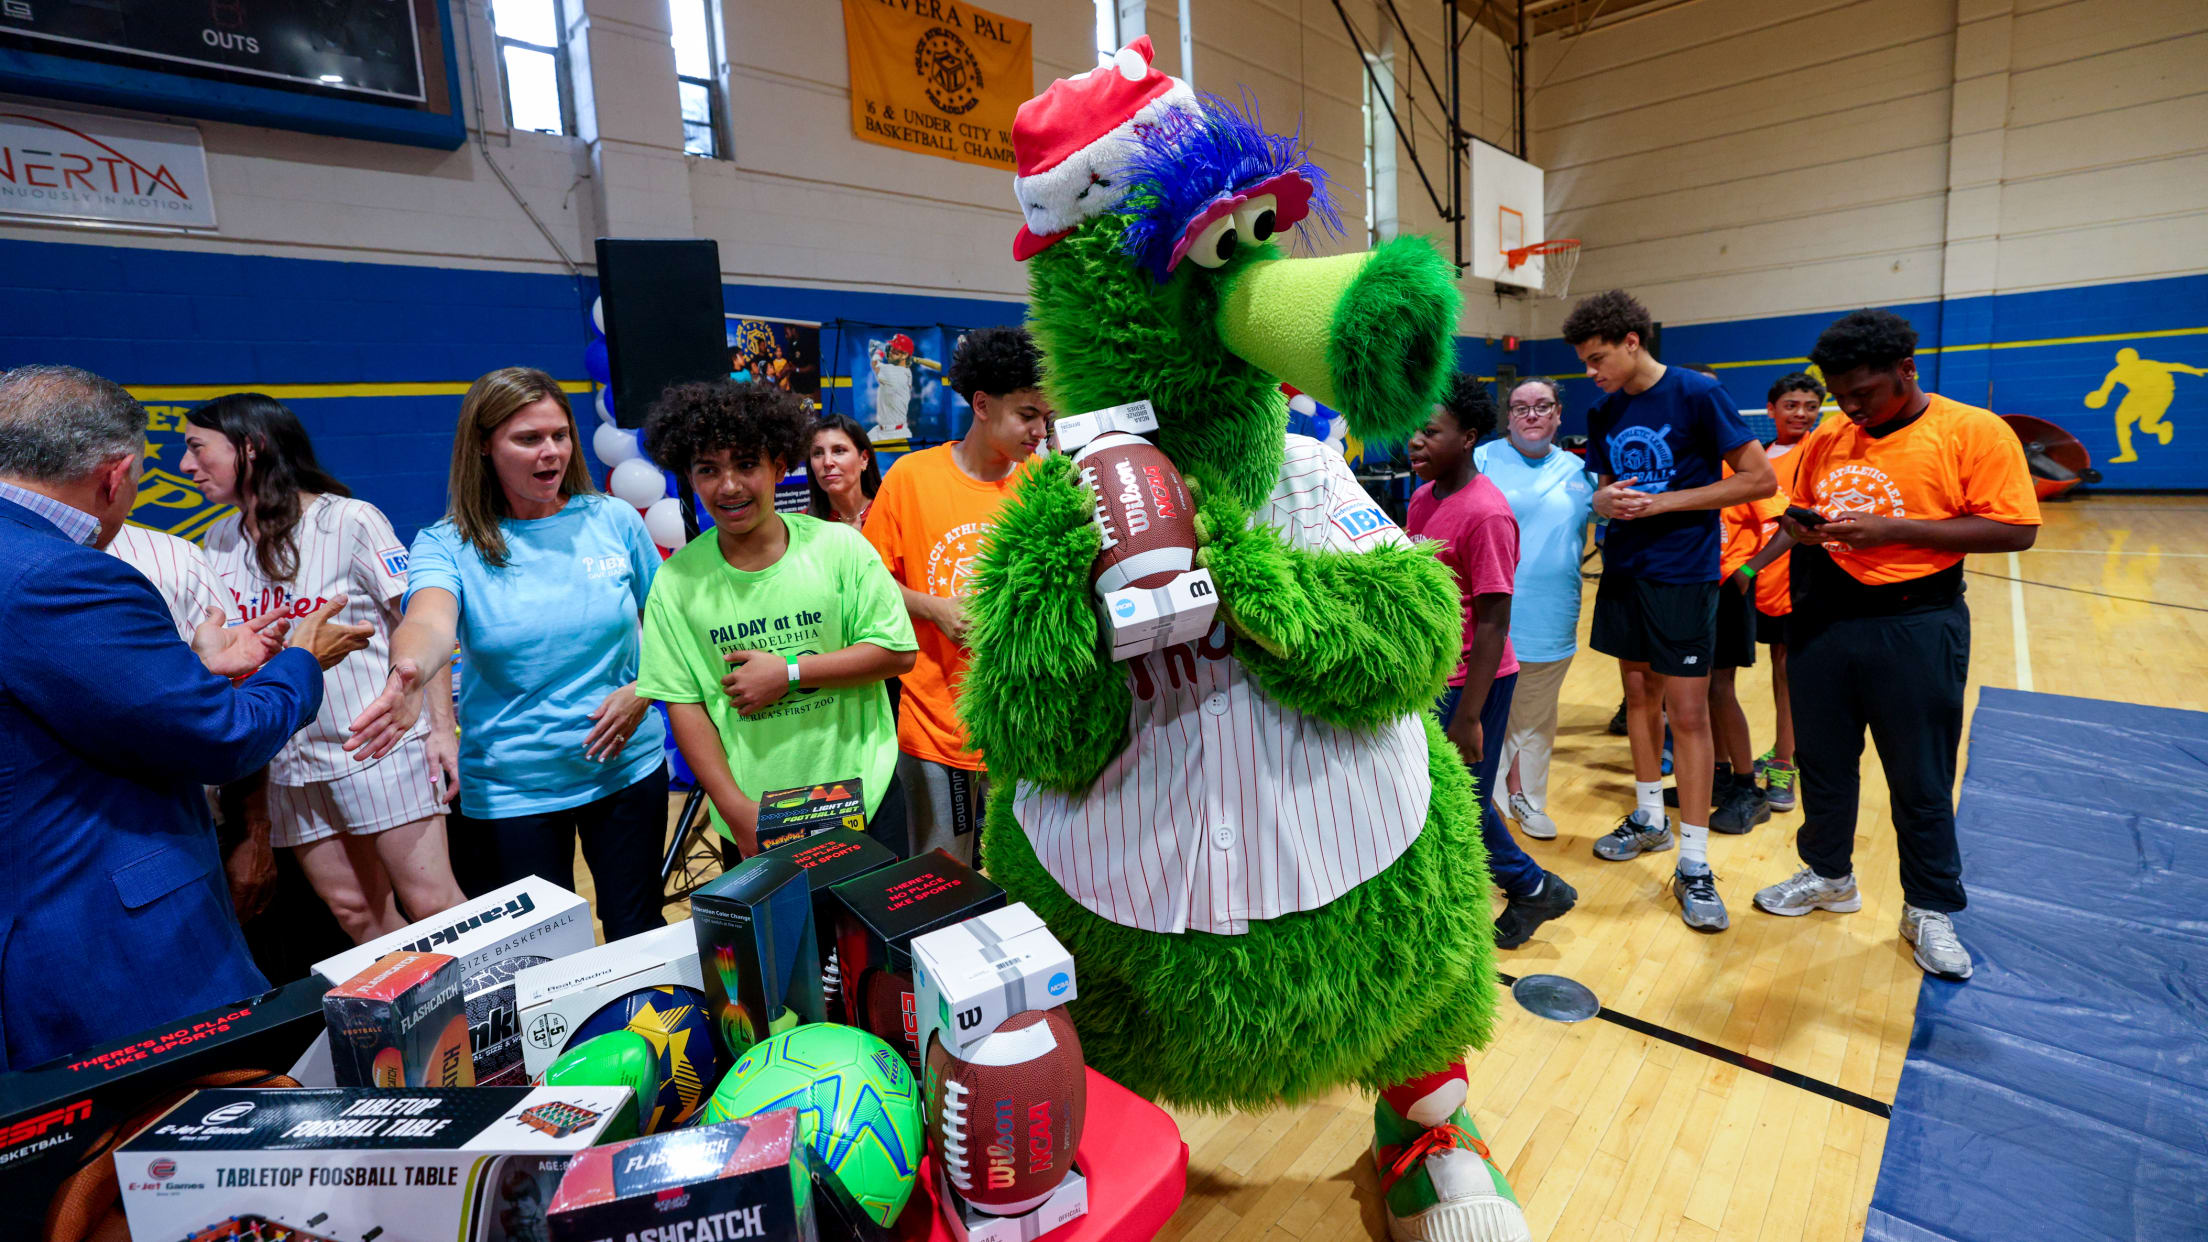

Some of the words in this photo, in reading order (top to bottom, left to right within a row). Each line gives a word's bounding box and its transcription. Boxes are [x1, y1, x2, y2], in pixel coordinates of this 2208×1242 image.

[202, 28, 260, 54] OUTS
[973, 13, 1012, 45] PAL
[865, 115, 958, 152] BASKETBALL
[904, 108, 952, 133] UNDER
[958, 122, 992, 142] CITY
[121, 198, 193, 211] MOTION
[1115, 459, 1150, 537] Wilson
[1142, 464, 1177, 519] NCAA
[1339, 508, 1393, 537] IBX
[709, 624, 739, 645] PAL
[737, 617, 767, 639] DAY
[774, 615, 792, 631] at
[795, 610, 823, 627] the
[784, 704, 812, 717] FIRST
[815, 696, 835, 709] ZOO
[783, 809, 837, 824] FOOTBALL
[839, 805, 860, 815] SET
[812, 802, 843, 813] LIGHT
[792, 840, 836, 859] THERE'S
[794, 854, 813, 865] NO
[813, 842, 848, 861] PLACE
[819, 843, 862, 864] SPORTS
[885, 872, 935, 894] THERE'S
[887, 898, 915, 912] LIKE
[914, 878, 963, 901] SPORTS
[888, 890, 908, 902] NO
[908, 876, 946, 895] PLACE
[715, 910, 730, 918] Color
[730, 913, 751, 922] Change
[460, 952, 490, 972] SIZE
[495, 915, 575, 956] BASKETBALL
[547, 981, 572, 992] Real
[574, 968, 613, 983] Madrid
[1050, 979, 1070, 993] NCAA
[400, 981, 460, 1035] FLASHCATCH
[67, 1039, 157, 1072] THERE'S
[159, 1028, 189, 1043] NO
[192, 1007, 252, 1032] PLACE
[533, 1027, 546, 1042] 13
[550, 1025, 566, 1036] 5
[103, 1050, 149, 1071] LIKE
[152, 1024, 231, 1054] SPORTS
[339, 1098, 443, 1117] TABLETOP
[280, 1119, 389, 1139] FOOSBALL
[379, 1119, 453, 1138] TABLE
[1028, 1100, 1054, 1175] NCAA
[987, 1097, 1016, 1190] Wilson
[128, 1182, 161, 1191] E-Jet
[166, 1182, 205, 1190] Games
[216, 1167, 304, 1188] TABLETOP
[309, 1166, 398, 1187] FOOSBALL
[404, 1166, 459, 1186] TABLE
[590, 1203, 766, 1242] ASHCATCH
[1058, 1206, 1082, 1223] OFFICIAL
